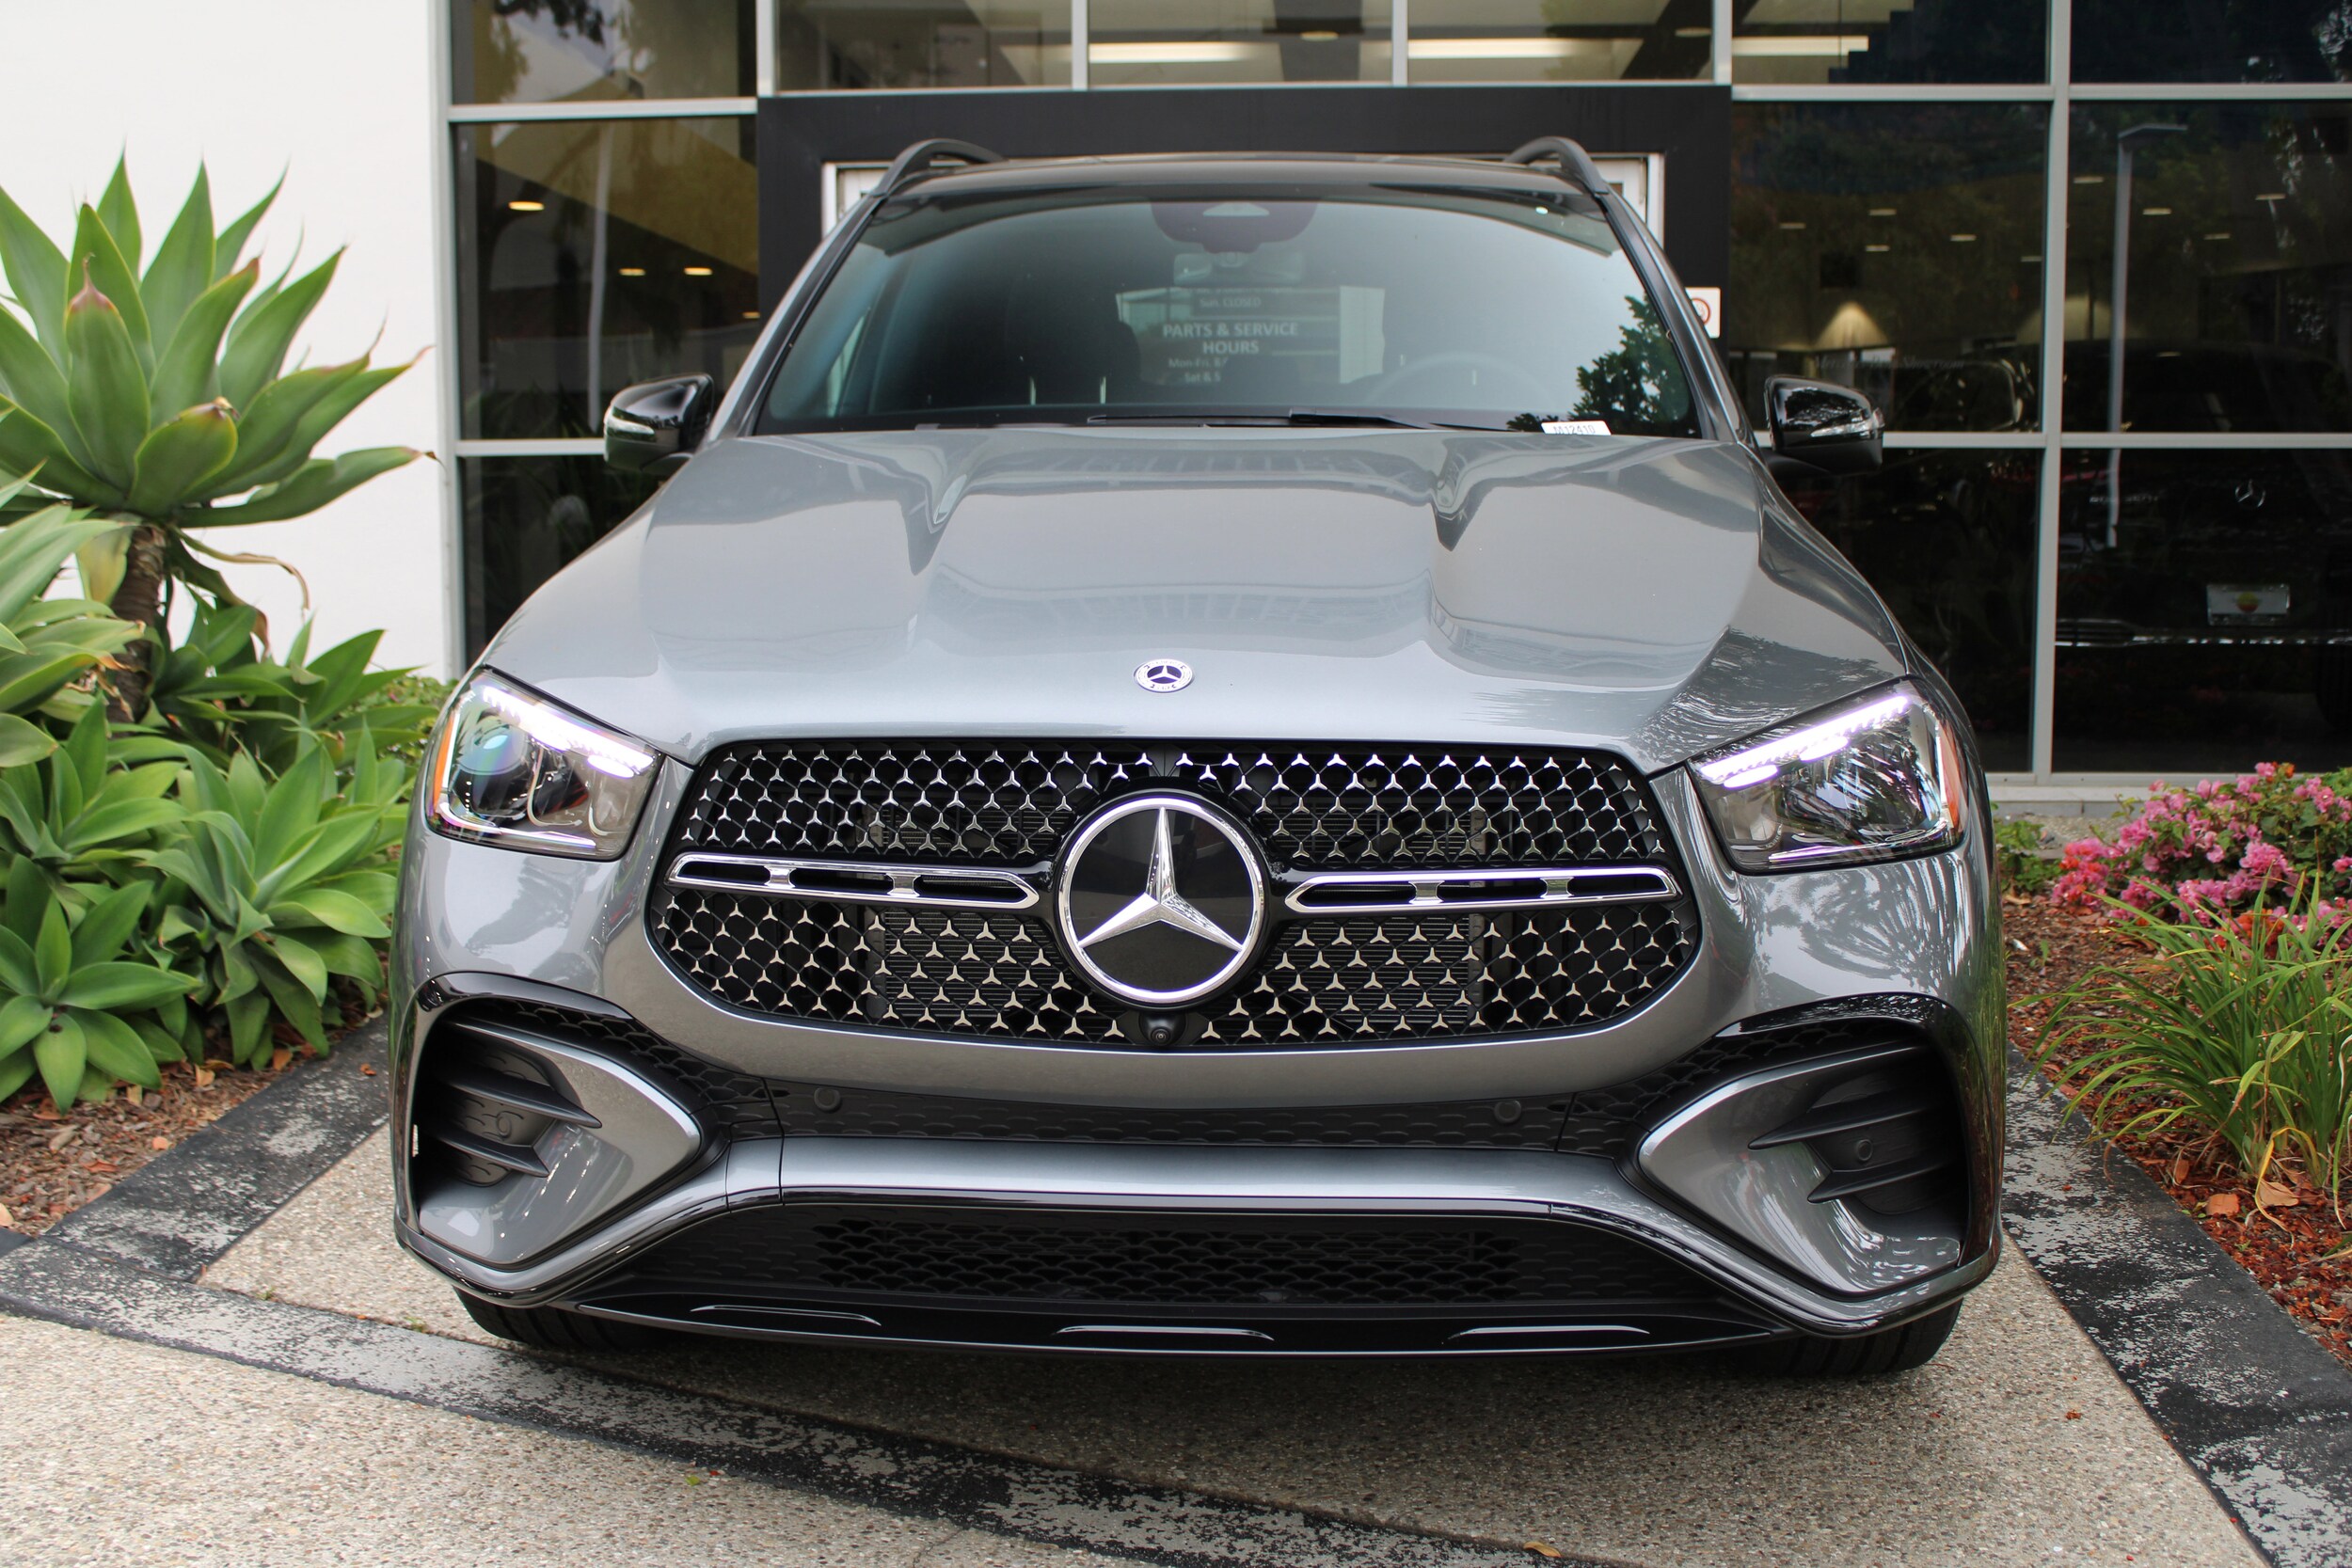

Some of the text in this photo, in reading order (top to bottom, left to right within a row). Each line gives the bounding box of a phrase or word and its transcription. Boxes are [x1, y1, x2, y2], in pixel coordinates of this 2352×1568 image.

[1222, 298, 1262, 308] CLOSED
[1163, 322, 1298, 338] PARTS & SERVICE
[1202, 341, 1260, 355] HOURS
